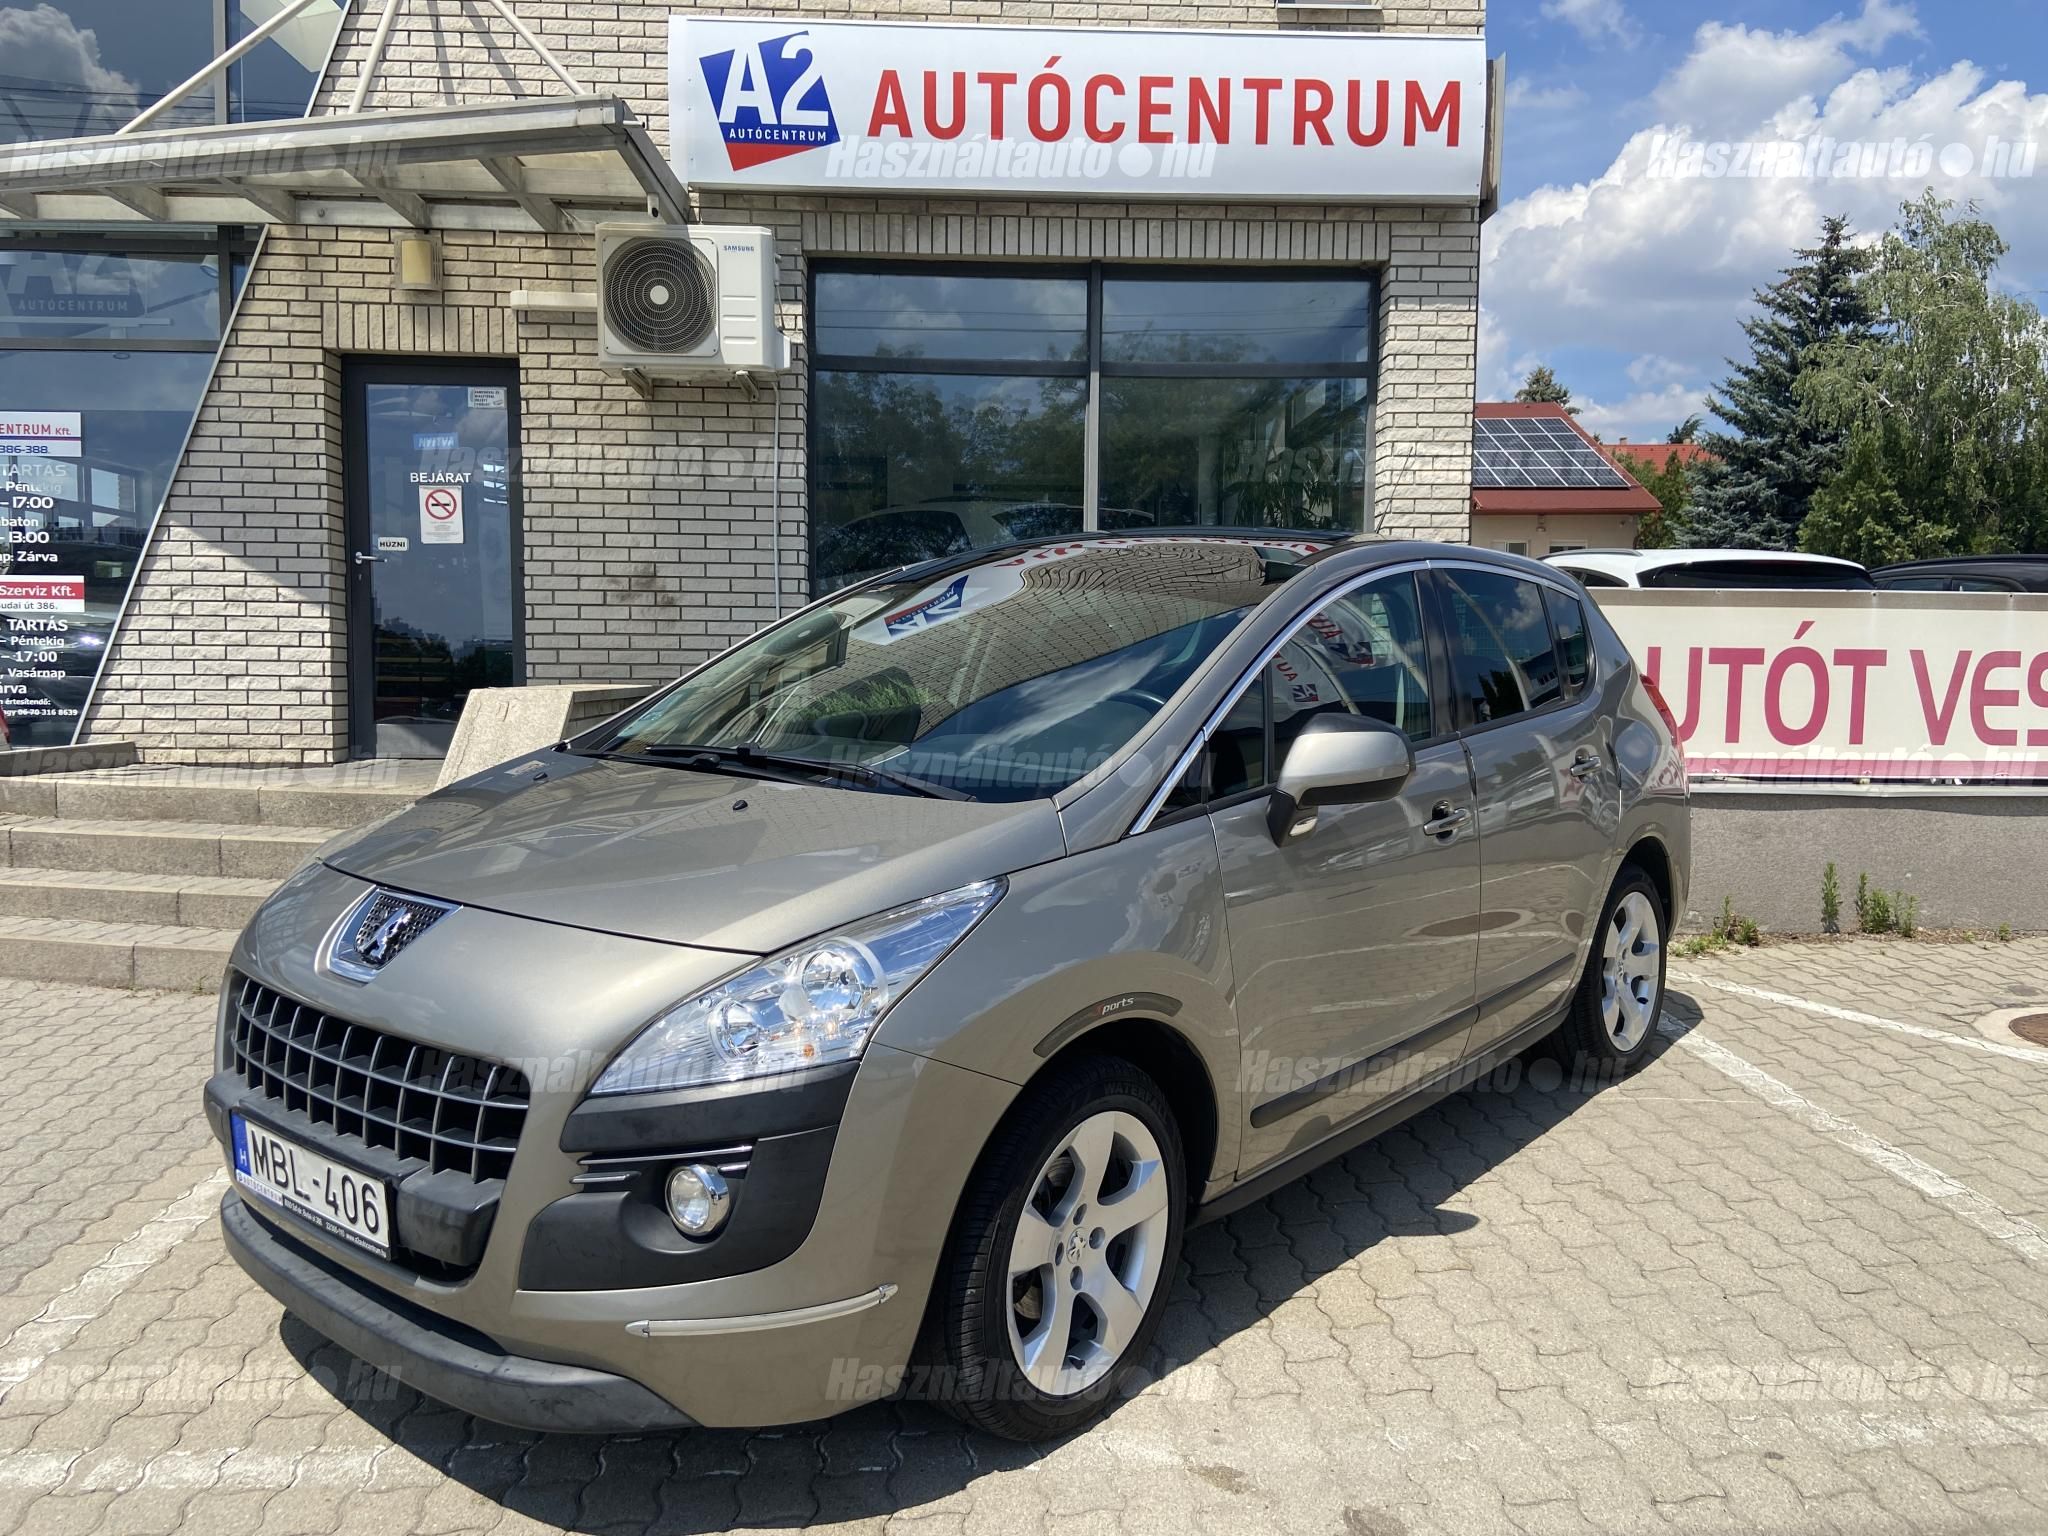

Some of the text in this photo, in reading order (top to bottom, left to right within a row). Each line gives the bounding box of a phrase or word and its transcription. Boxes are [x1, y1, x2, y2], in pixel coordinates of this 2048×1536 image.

[718, 33, 829, 126] A2
[867, 55, 1460, 148] AUTÓCENTRUM
[729, 126, 827, 142] AUTÓCENTRUM
[410, 470, 472, 483] BEJÁRAT
[12, 496, 54, 509] 17:00
[0, 516, 39, 527] baton
[8, 531, 50, 544] 13:00
[16, 550, 59, 562] Zárva
[0, 585, 76, 597] Szerviz Kft.
[0, 601, 58, 610] udai út 386.
[6, 615, 69, 632] TARTÁS
[10, 635, 65, 649] Péntekig
[15, 651, 58, 662] 17:00
[8, 667, 66, 681] Vasárnap
[1646, 620, 1888, 747] UTÓT
[58, 708, 79, 716] 8639
[239, 1148, 248, 1167] H
[251, 1130, 379, 1234] MBL-406
